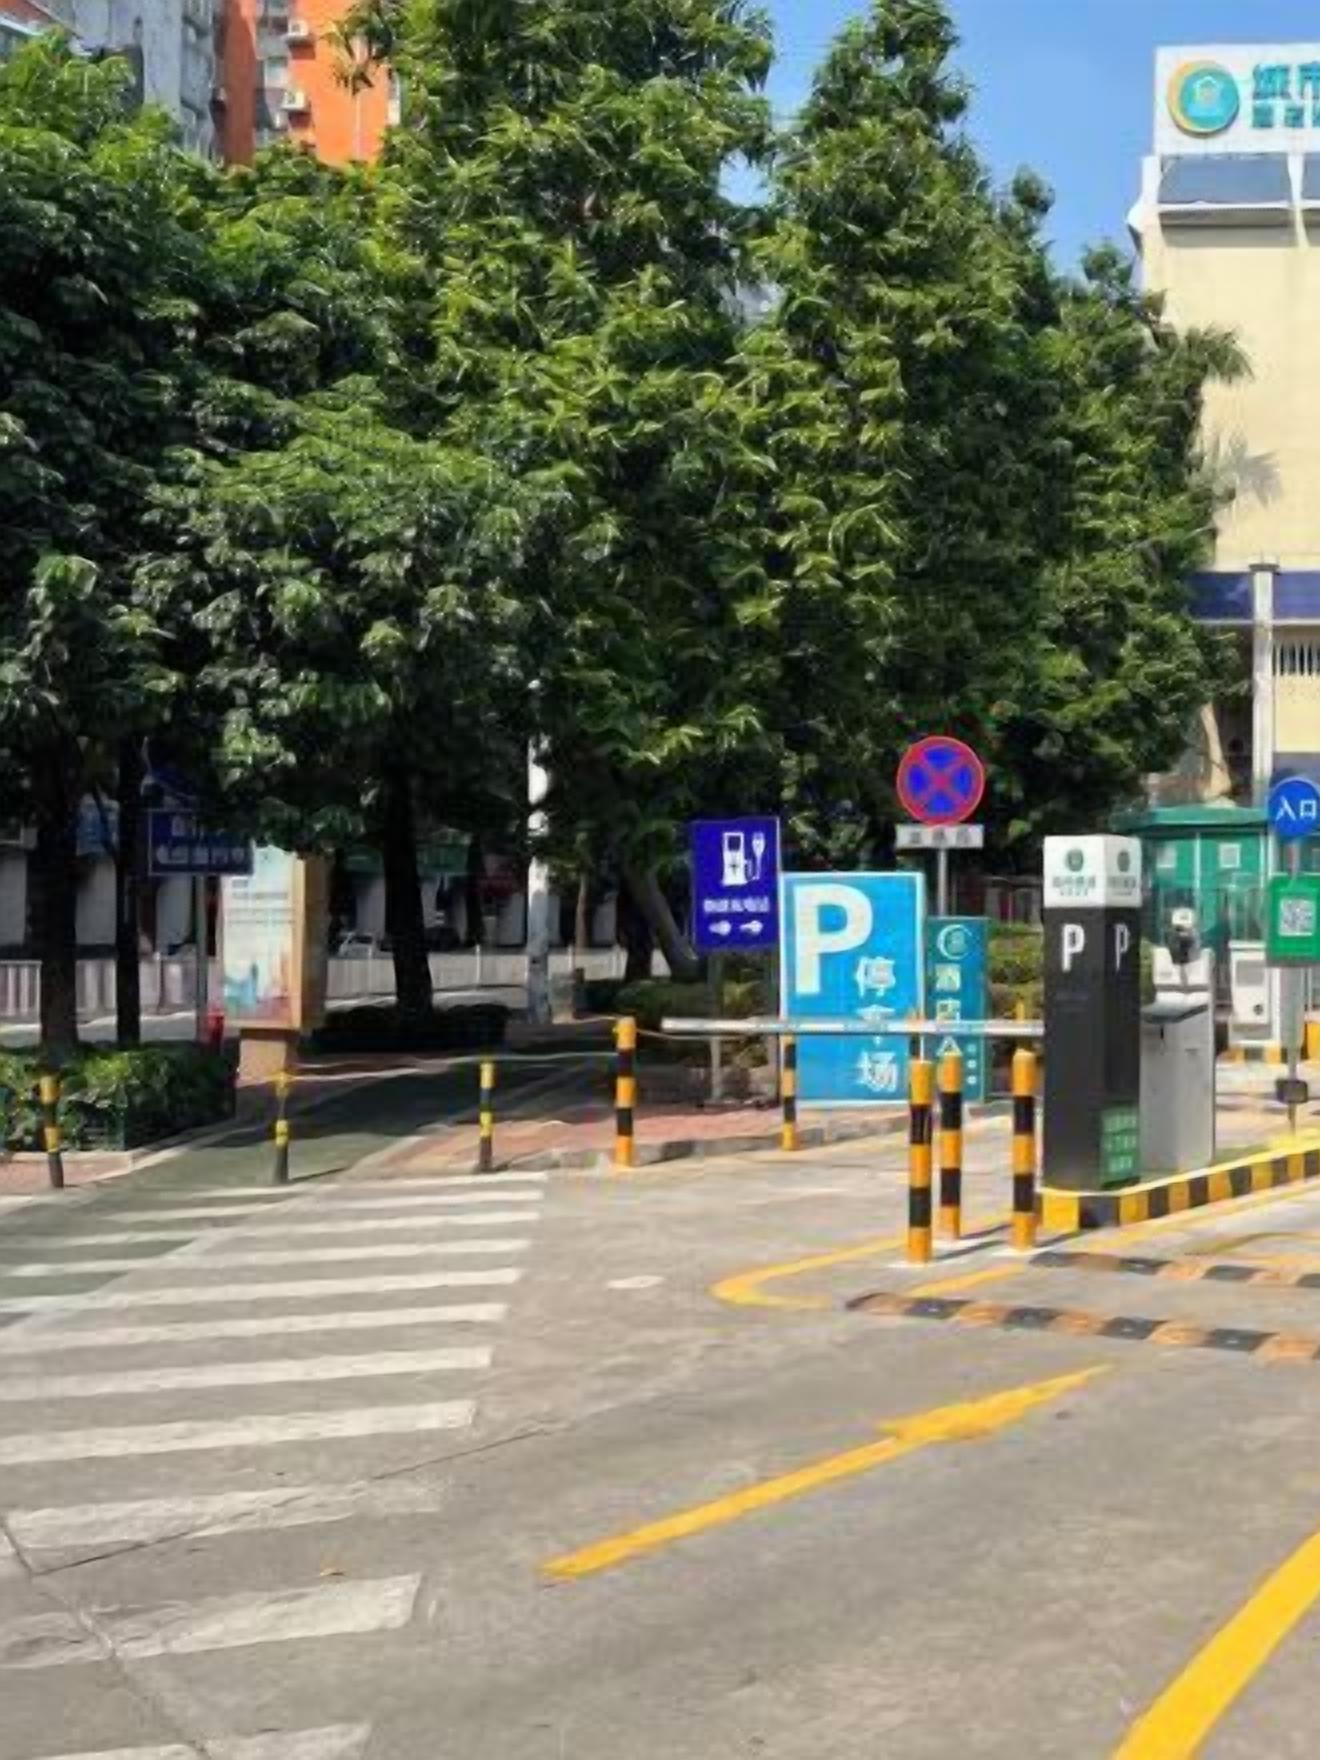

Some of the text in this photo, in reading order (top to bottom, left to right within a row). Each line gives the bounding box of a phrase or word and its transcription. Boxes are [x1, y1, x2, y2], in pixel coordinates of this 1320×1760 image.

[1276, 796, 1317, 821] 入口
[795, 884, 873, 994] P
[1061, 922, 1085, 974] P
[1114, 923, 1130, 973] P
